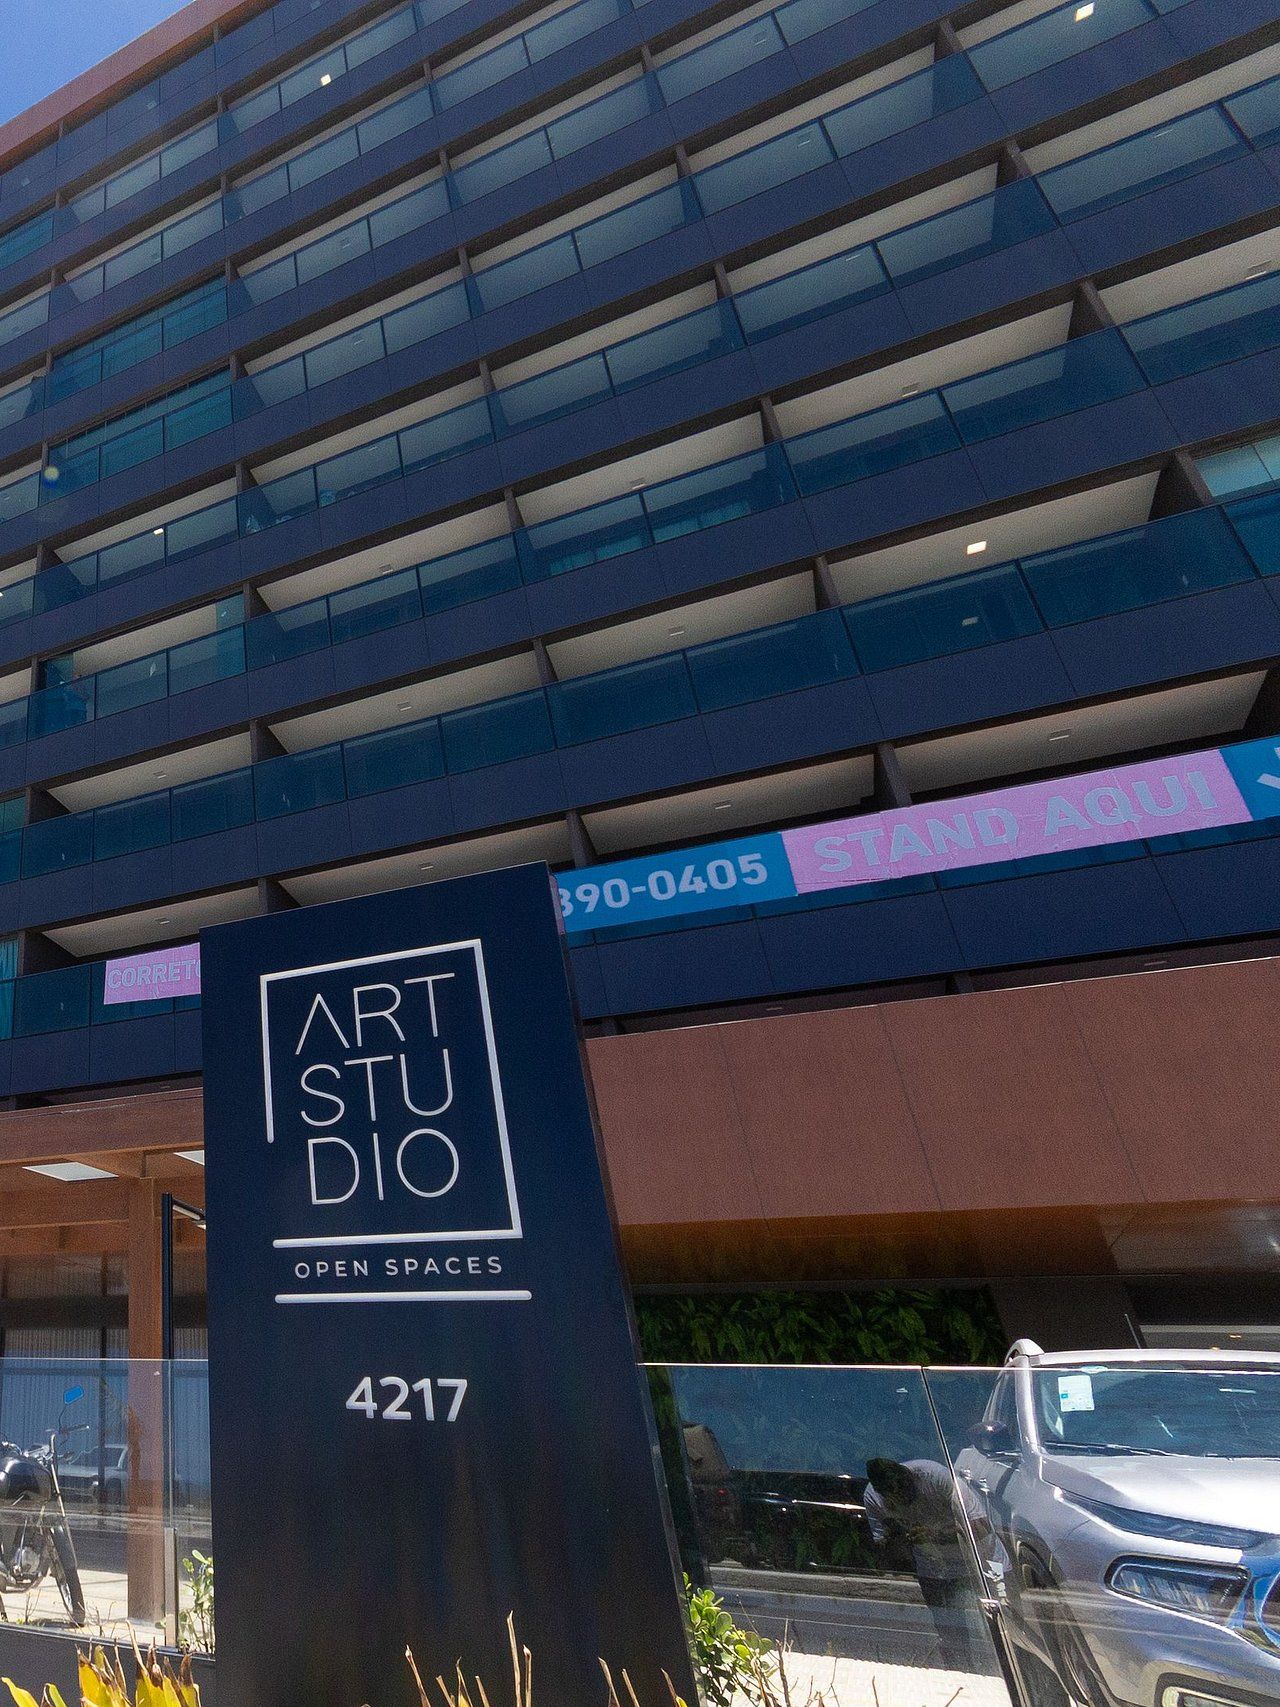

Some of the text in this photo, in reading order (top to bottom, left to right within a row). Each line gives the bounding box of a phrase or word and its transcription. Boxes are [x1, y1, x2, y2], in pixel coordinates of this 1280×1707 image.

[813, 770, 1219, 874] STAND AQUI
[295, 972, 456, 1055] ART
[300, 1048, 454, 1128] STU
[307, 1128, 460, 1206] DIO
[294, 1256, 503, 1279] OPEN SPACES
[345, 1376, 468, 1422] 4217
